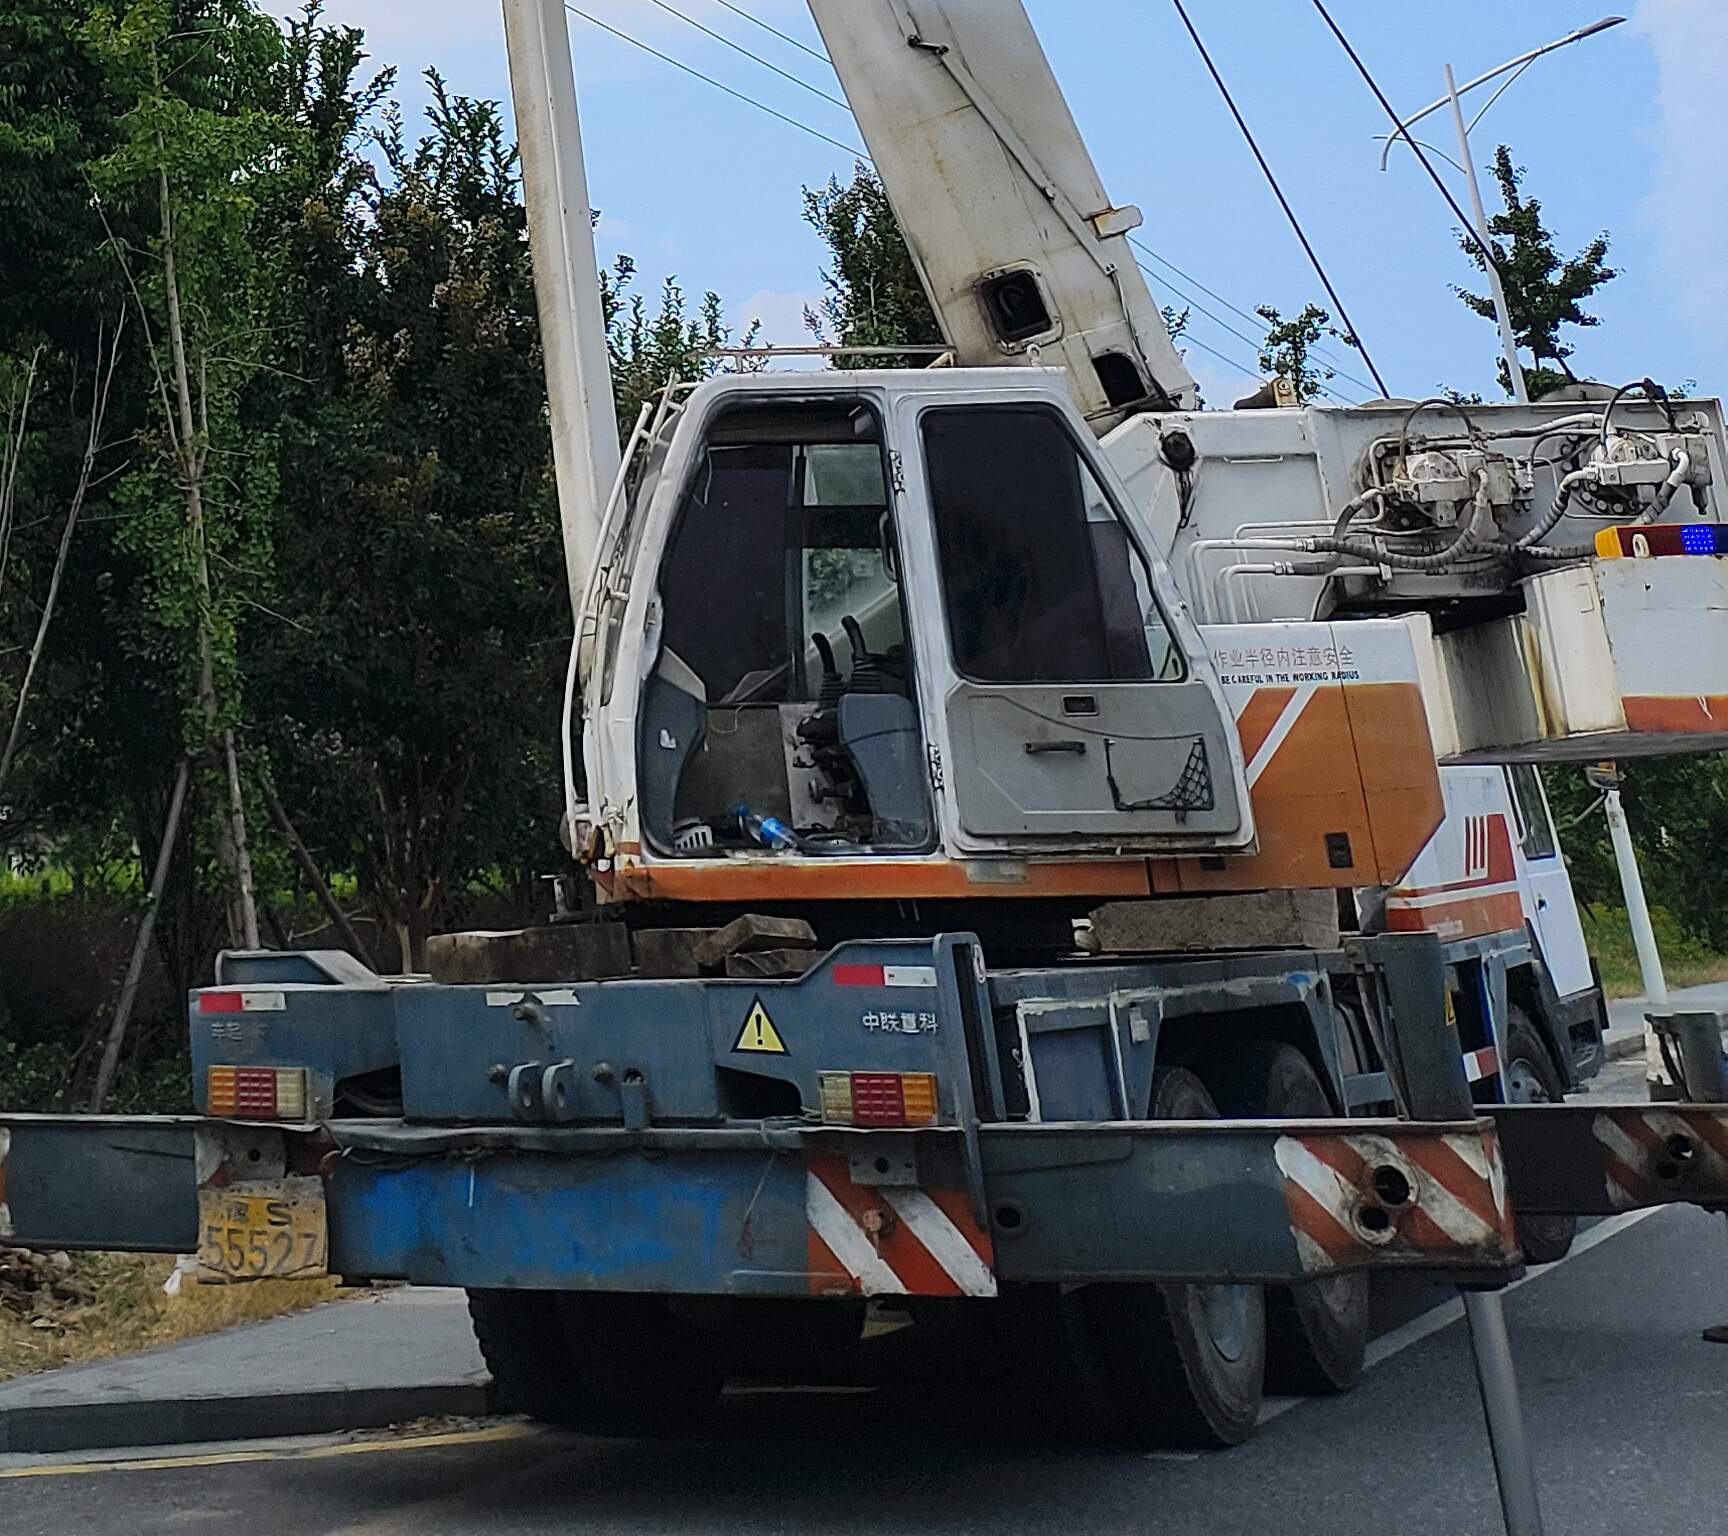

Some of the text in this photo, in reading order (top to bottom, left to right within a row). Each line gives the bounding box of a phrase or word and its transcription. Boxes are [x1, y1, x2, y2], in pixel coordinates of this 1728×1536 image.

[1276, 673, 1290, 683] THE
[1293, 671, 1328, 682] WORKING
[1331, 670, 1359, 680] RADIUS
[207, 1225, 318, 1276] 55527
